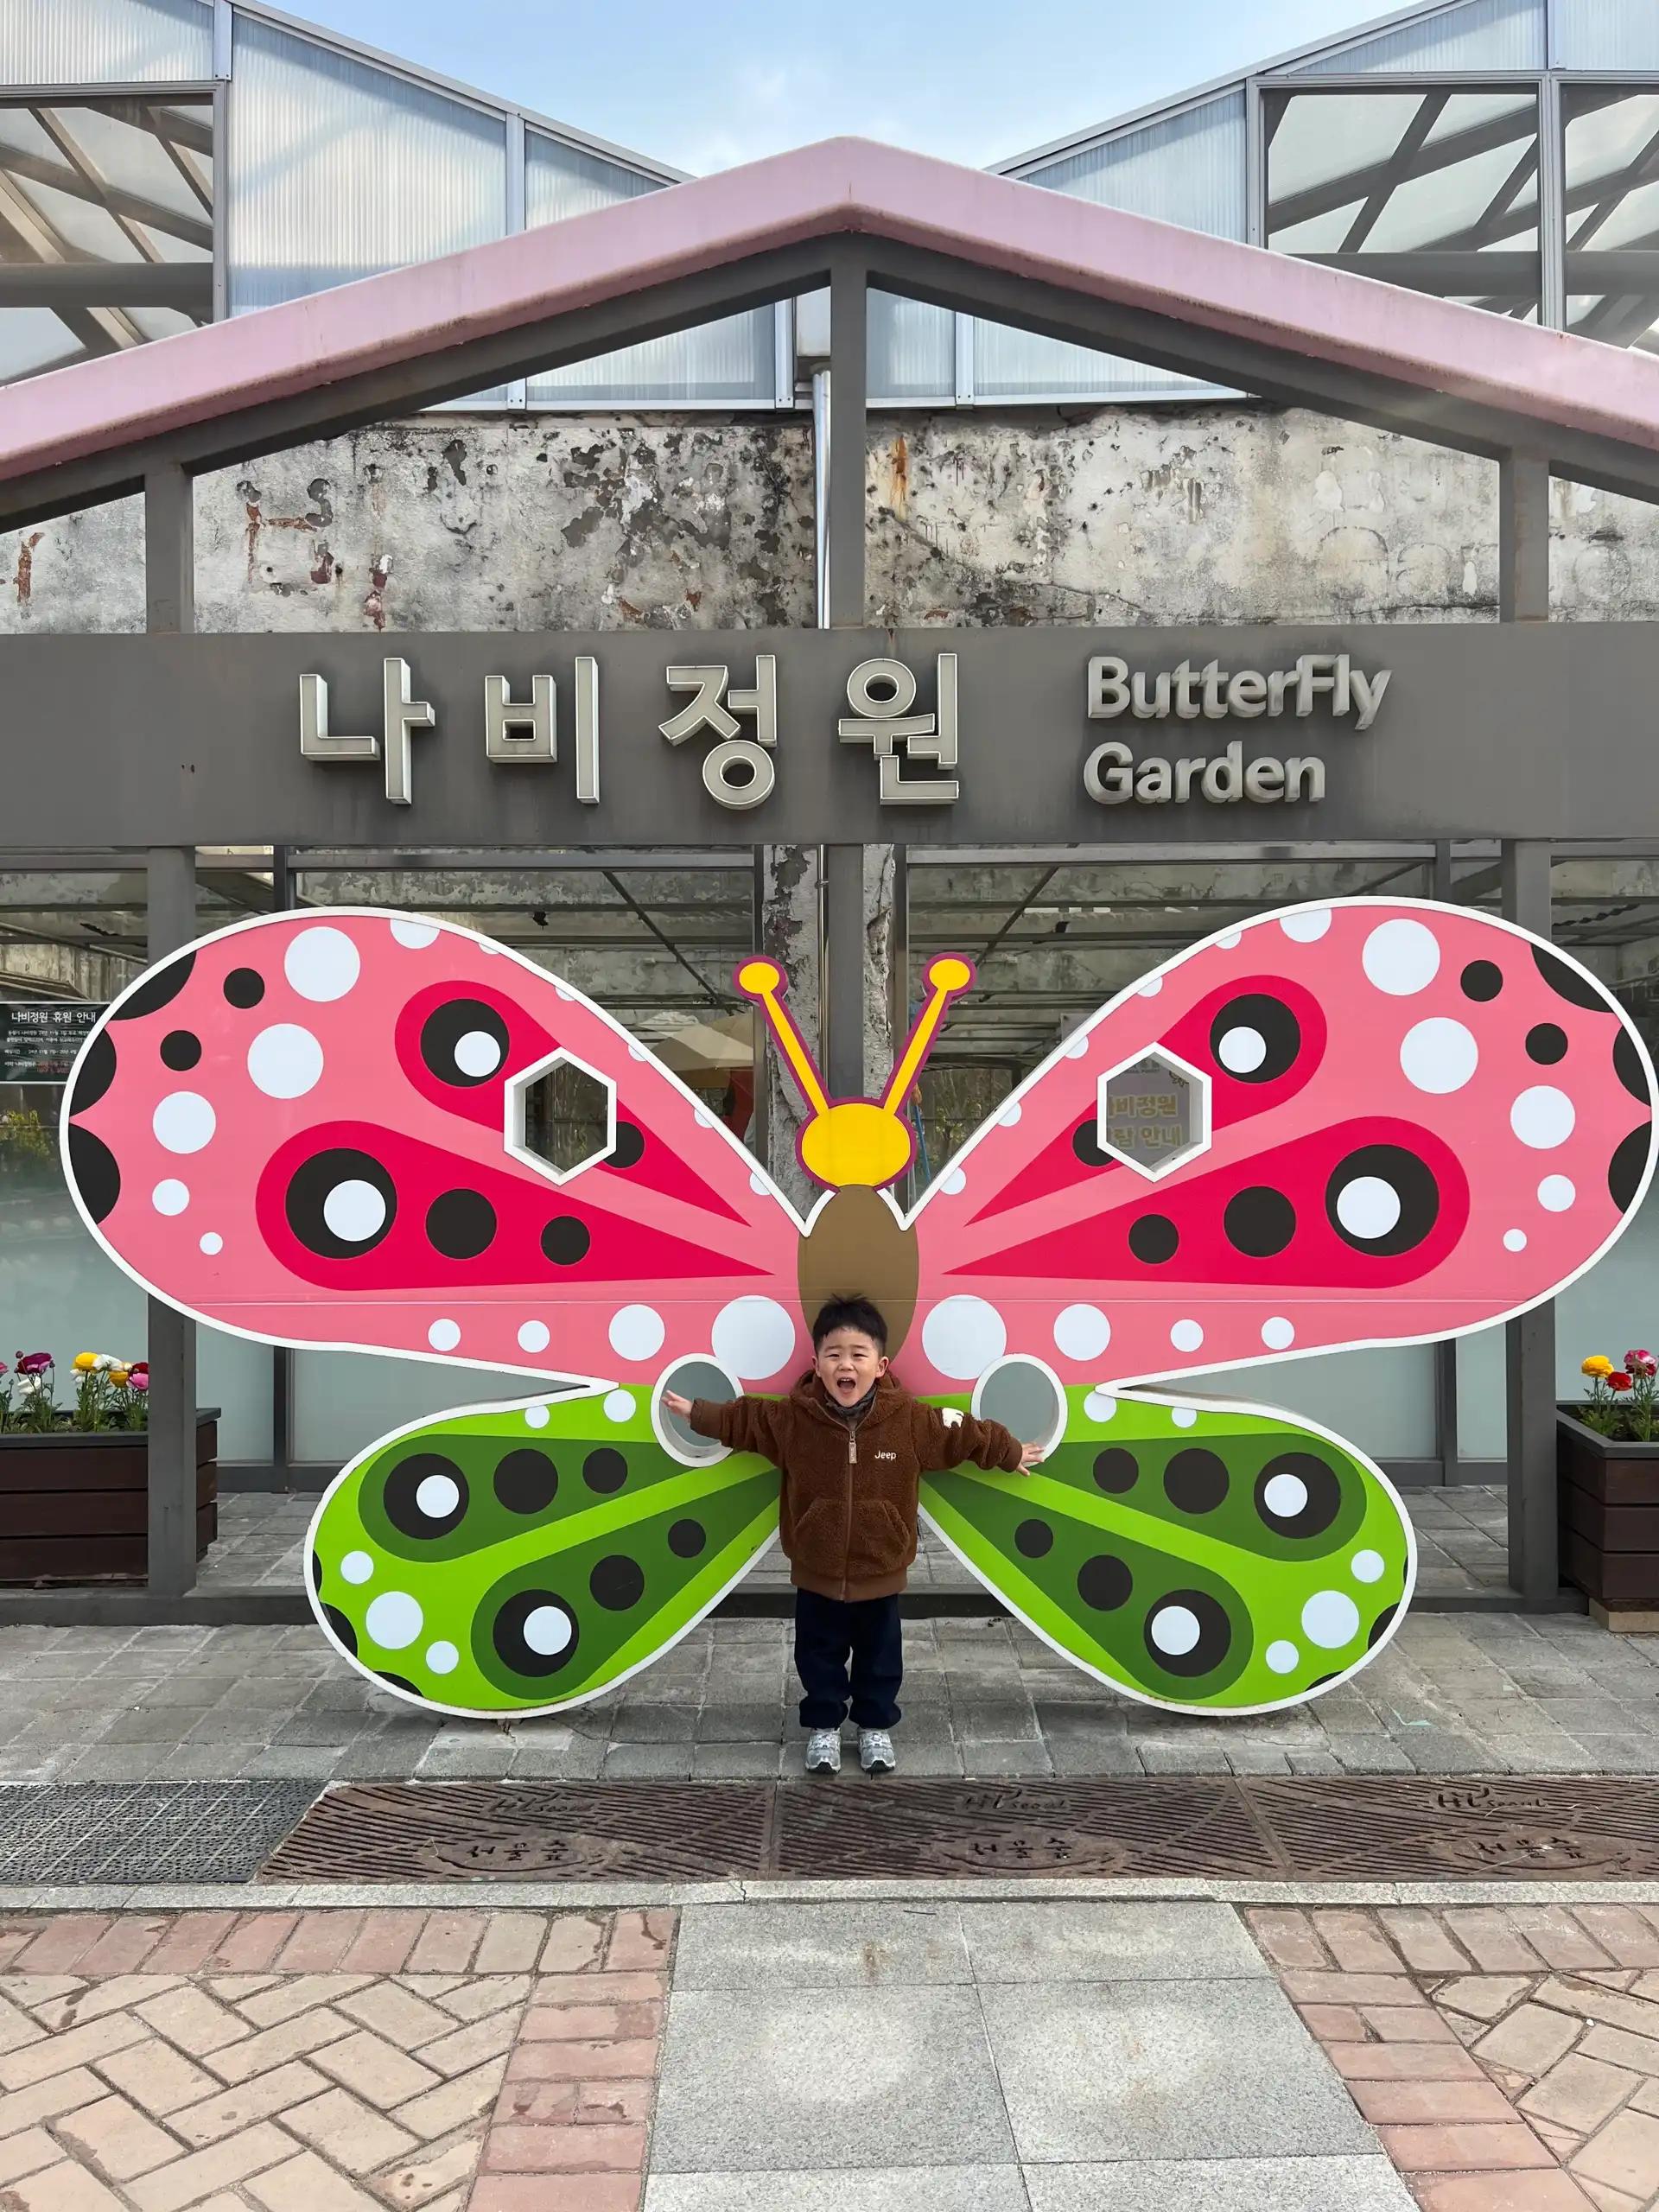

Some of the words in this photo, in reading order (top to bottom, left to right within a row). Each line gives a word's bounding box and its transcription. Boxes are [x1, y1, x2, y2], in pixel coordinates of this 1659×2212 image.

[1087, 653, 1392, 730] ButterFly
[300, 654, 959, 810] 나비정원
[1084, 741, 1326, 804] Garden
[11, 1011, 48, 1023] 나비정원
[52, 1011, 72, 1023] 휴원
[76, 1011, 96, 1023] 안내
[1141, 1124, 1181, 1148] 안내
[874, 1450, 896, 1461] Jeep
